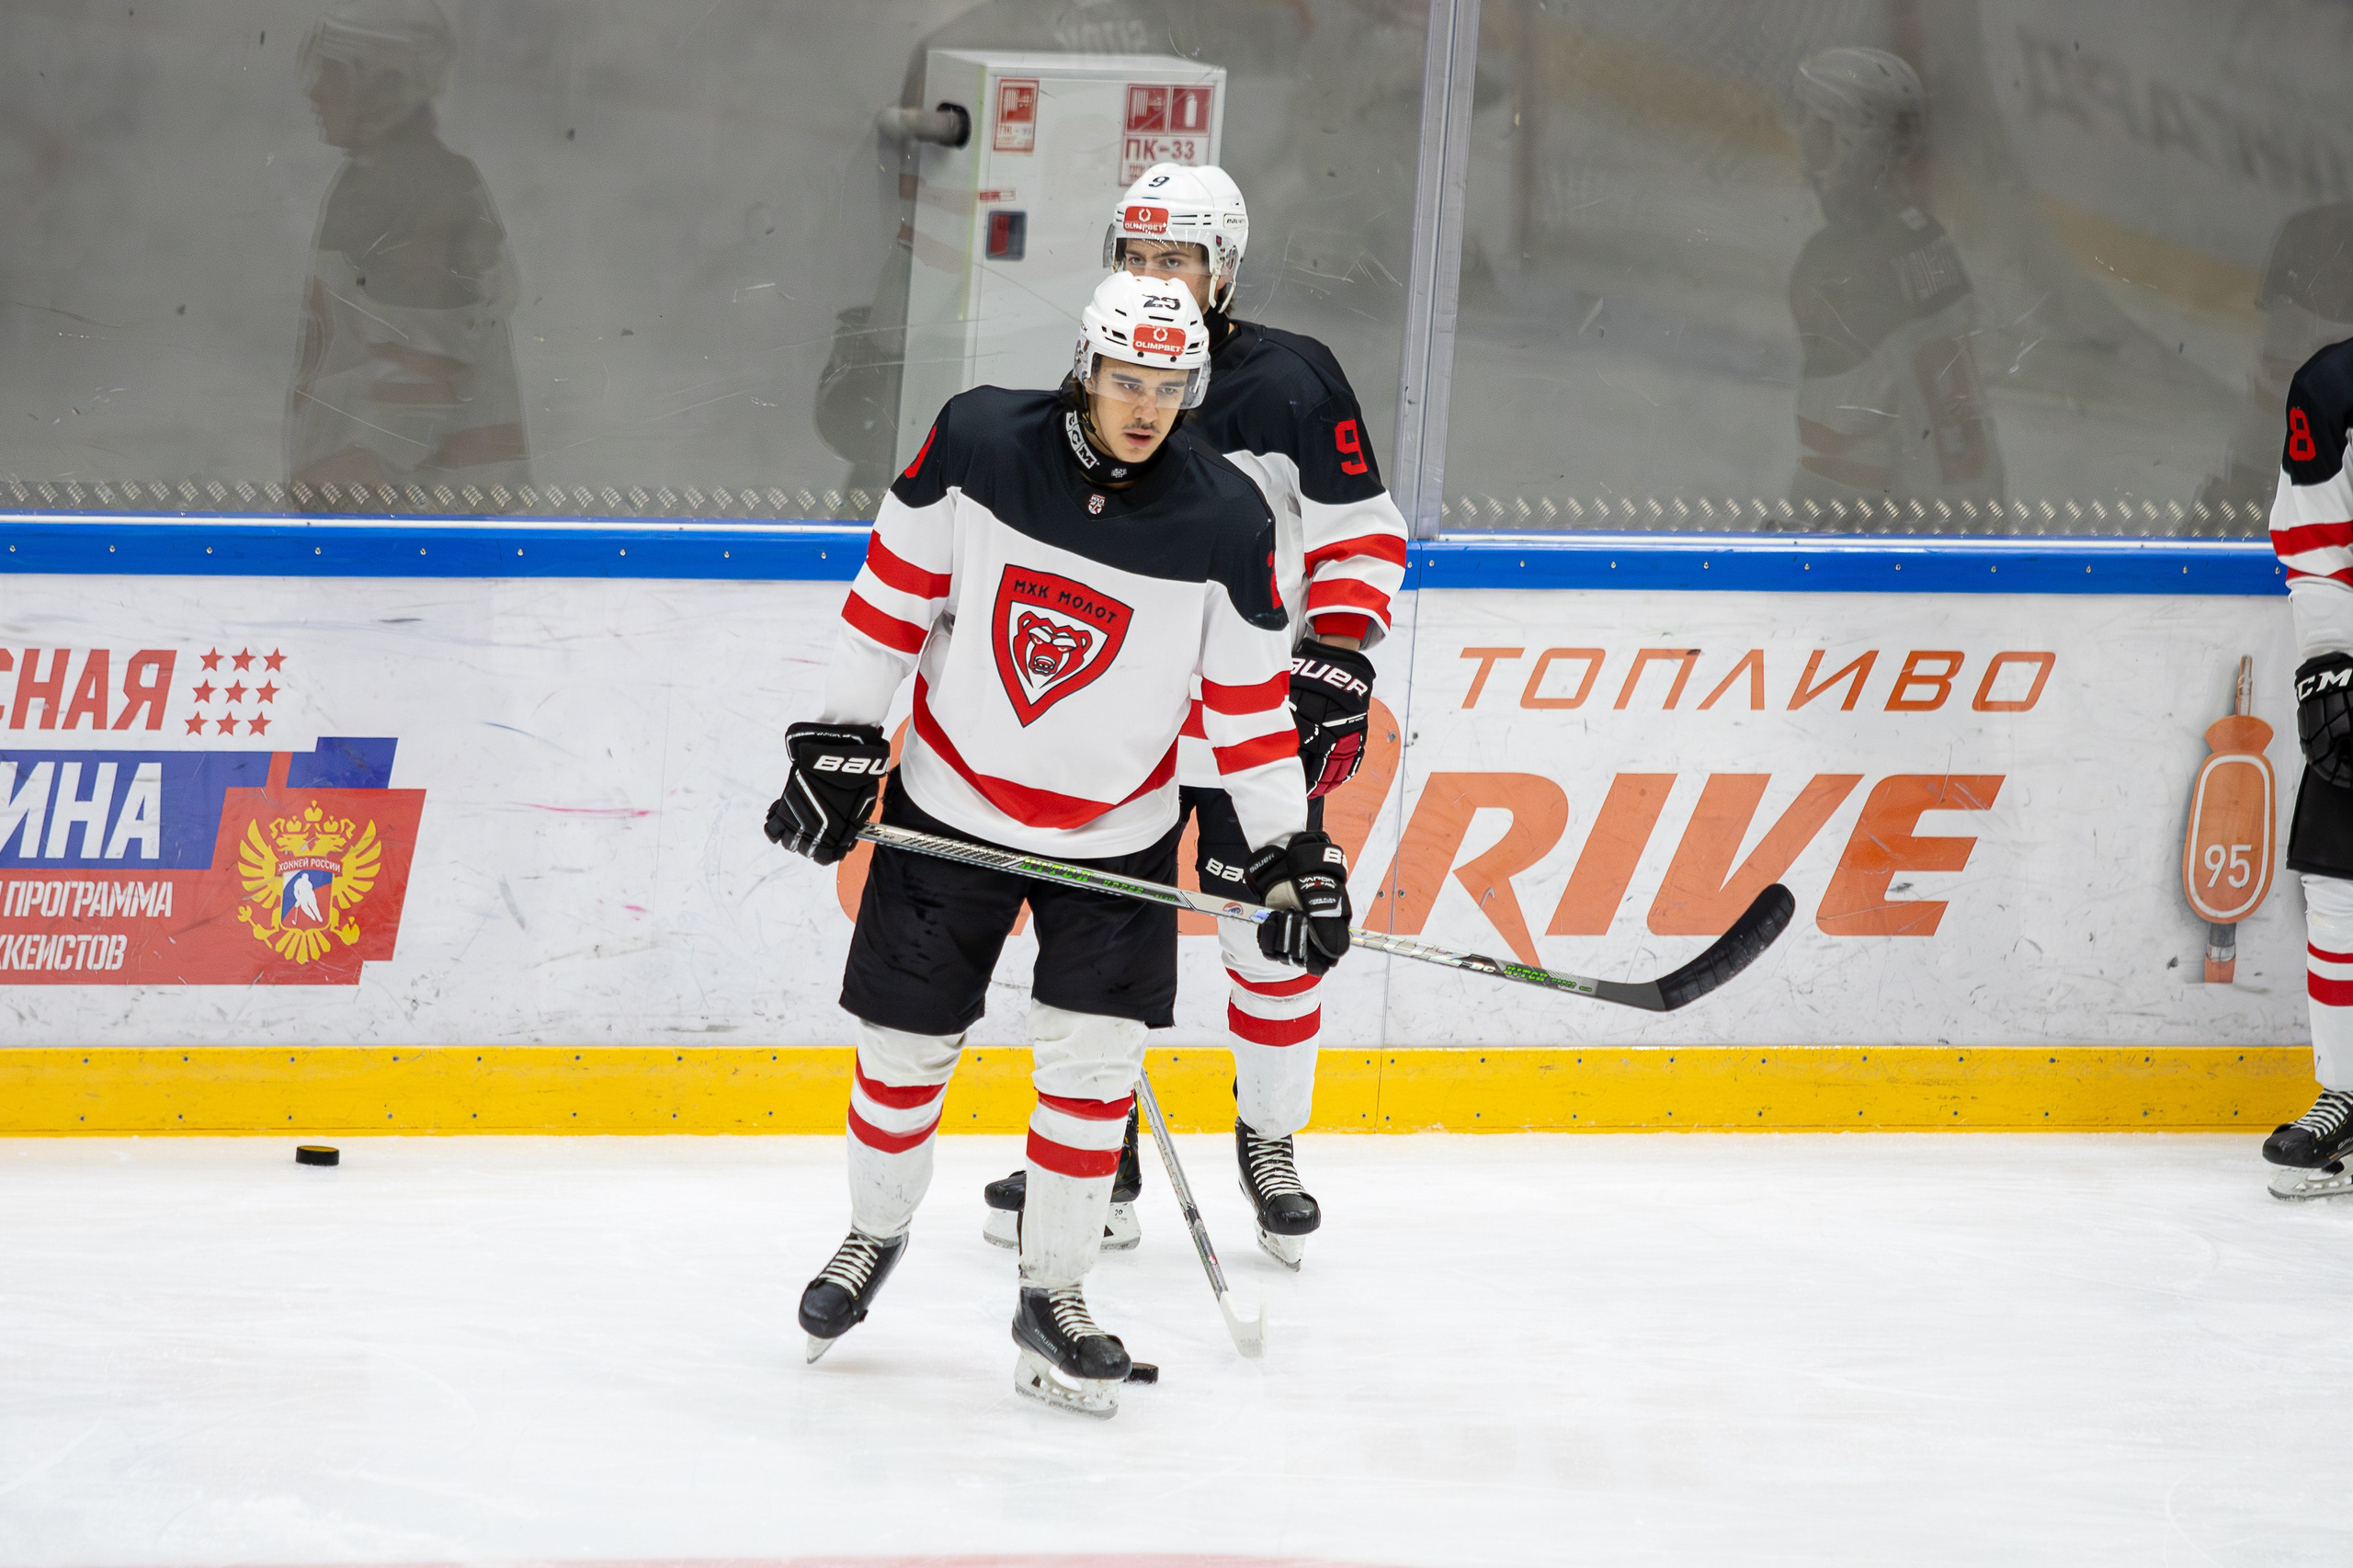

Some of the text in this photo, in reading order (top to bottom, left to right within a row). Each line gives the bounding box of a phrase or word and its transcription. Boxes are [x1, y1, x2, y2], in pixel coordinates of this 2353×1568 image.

[1125, 139, 1195, 161] ПК-33
[1148, 176, 1170, 187] 9
[1135, 340, 1182, 353] OLIMPBET
[1335, 419, 1369, 476] 9
[2289, 406, 2316, 461] 8
[1013, 579, 1118, 624] МХК МОЛОТ
[1290, 657, 1369, 697] AUER
[1460, 647, 2056, 711] ТОПЛИВО
[0, 761, 163, 859] ИНА
[1186, 694, 2007, 968] RIVE
[278, 857, 342, 873] ХОККЕЙ РОССИИ
[2203, 845, 2253, 889] 95
[3, 880, 174, 917] ПРОГРАММА
